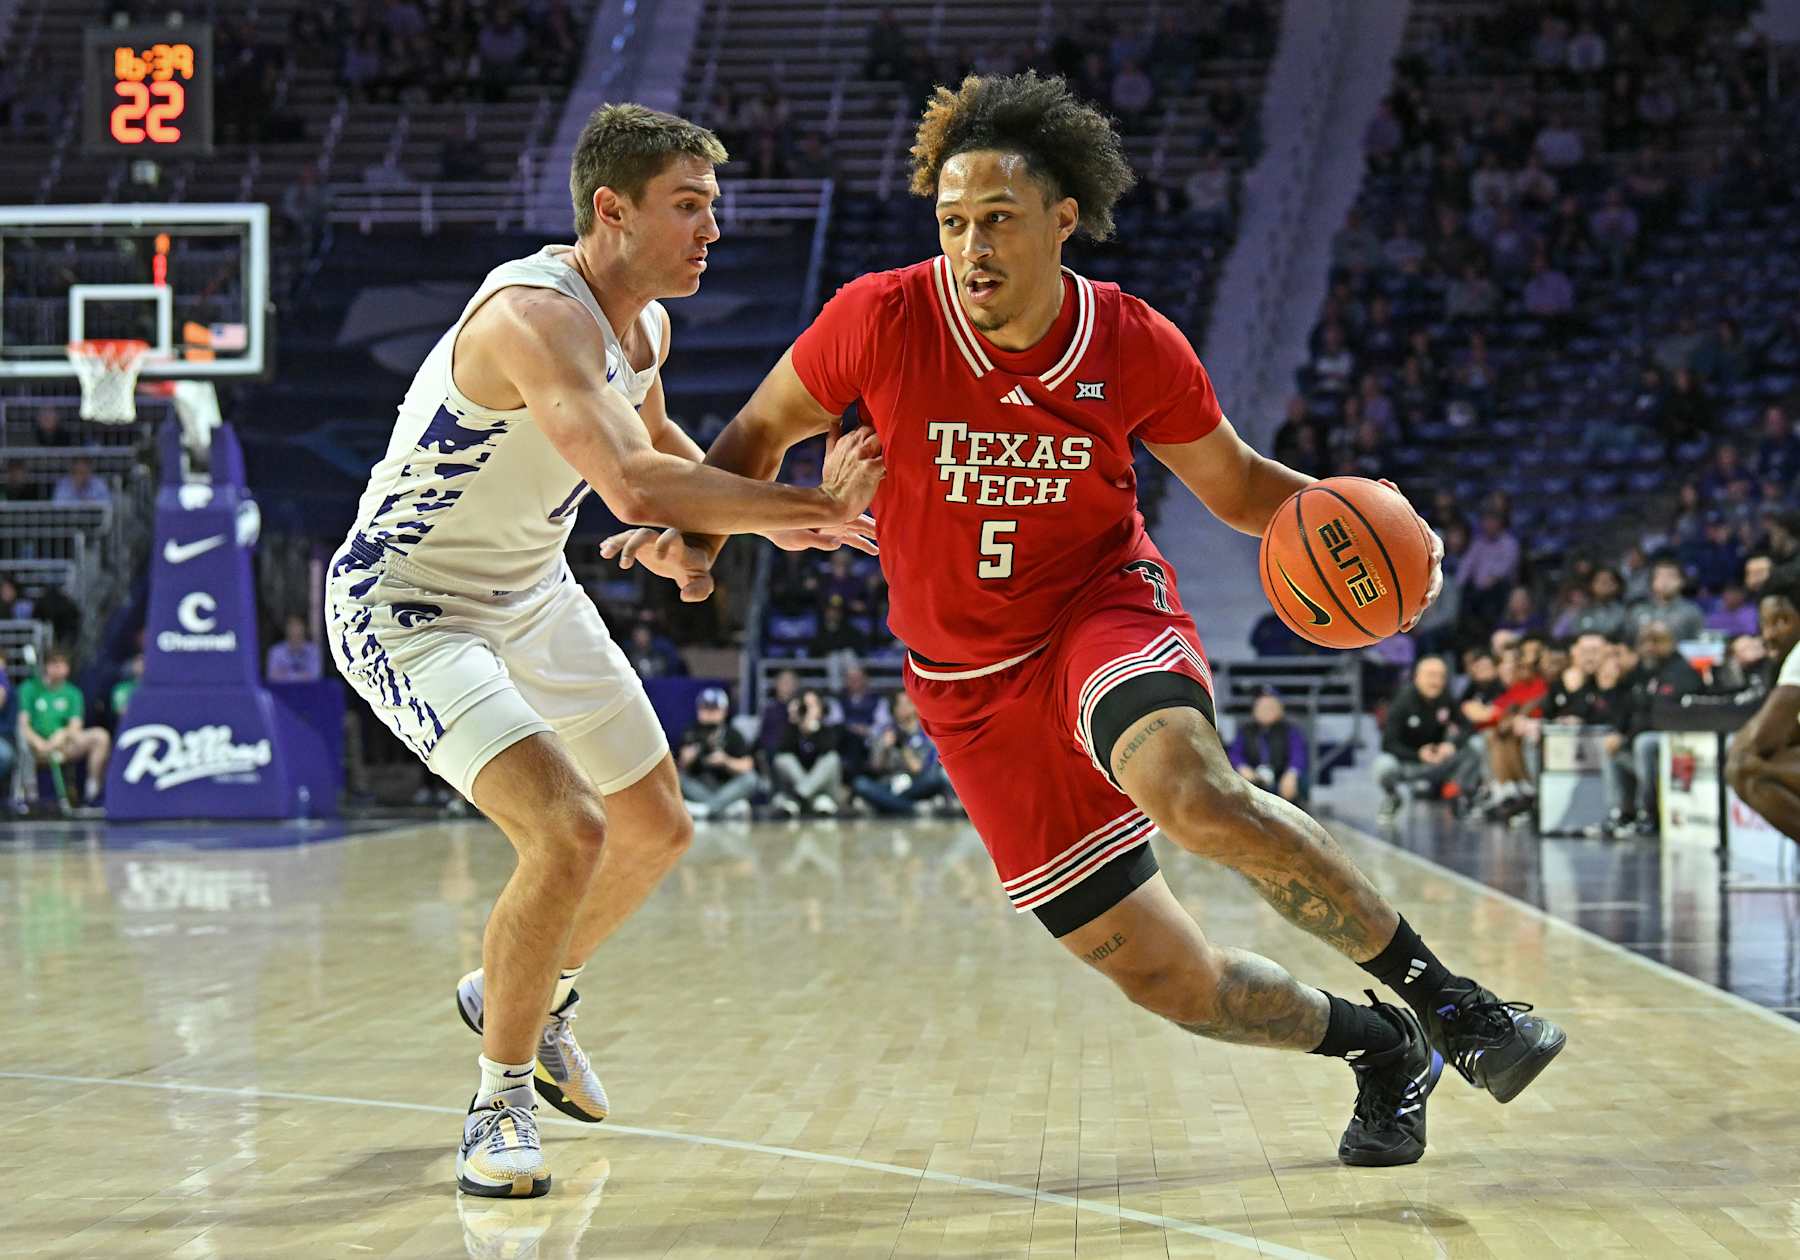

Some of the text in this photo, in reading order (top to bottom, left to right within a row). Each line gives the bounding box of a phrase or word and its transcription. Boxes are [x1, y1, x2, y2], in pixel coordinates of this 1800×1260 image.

[110, 80, 185, 144] 22
[1075, 381, 1105, 400] XII
[927, 421, 1093, 471] TEXAS
[938, 463, 1072, 507] TECH
[976, 519, 1018, 580] 5
[1316, 517, 1381, 608] ELITE
